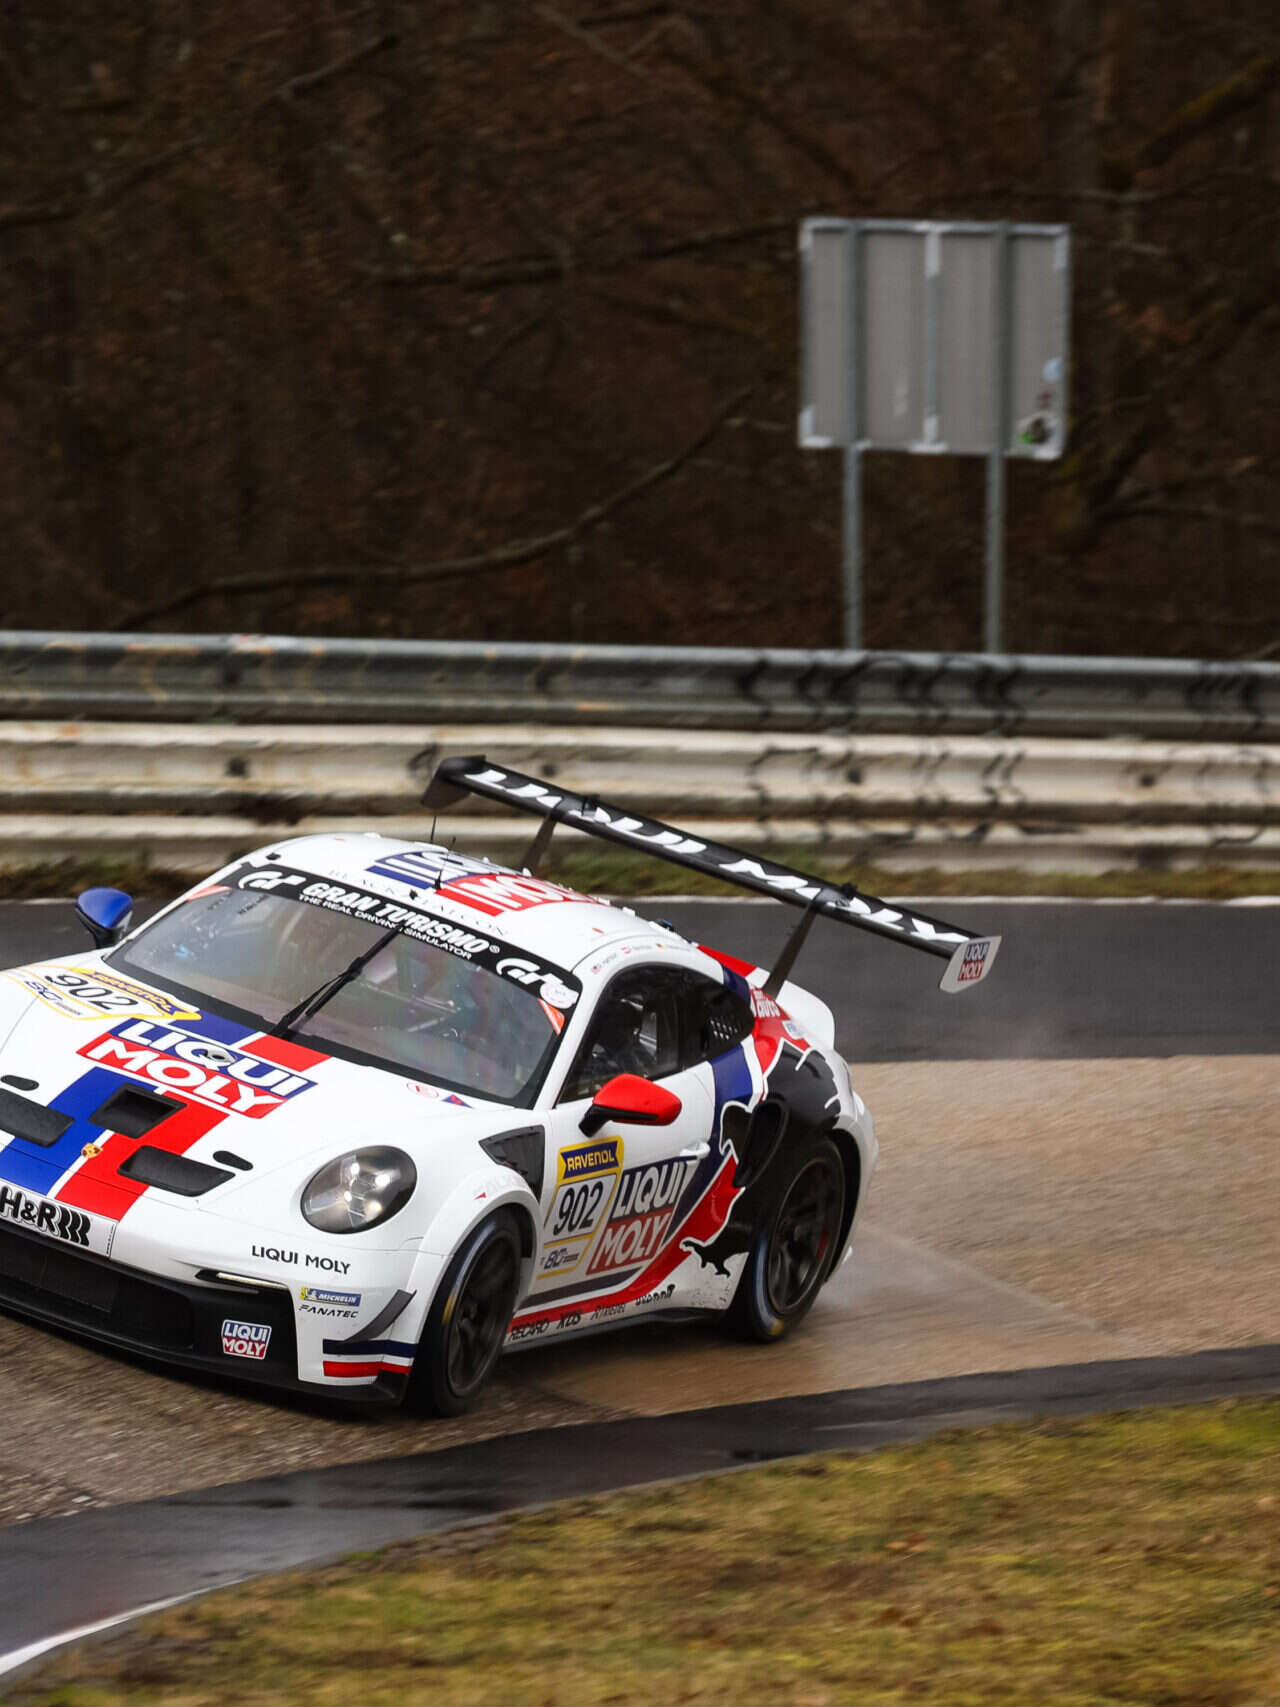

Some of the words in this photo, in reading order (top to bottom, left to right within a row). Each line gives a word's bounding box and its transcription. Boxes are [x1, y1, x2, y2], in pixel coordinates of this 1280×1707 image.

[302, 882, 381, 912] GRAN
[299, 893, 322, 906] THE
[322, 900, 353, 915] REAL
[403, 927, 472, 960] SIMULATOR
[44, 974, 139, 1011] 902
[86, 1037, 288, 1113] MOLY
[117, 1019, 309, 1098] LIQUI
[566, 1149, 616, 1171] RAVENOL
[613, 1160, 686, 1217] LIQUI
[553, 1180, 604, 1236] 902
[591, 1213, 672, 1271] MOLY
[251, 1244, 299, 1265] LIQUI
[305, 1254, 352, 1275] MOLY
[298, 1304, 359, 1319] FANATEC
[318, 1292, 358, 1303] MICHELIN
[222, 1339, 266, 1359] MOLY
[224, 1322, 268, 1342] LIQUI
